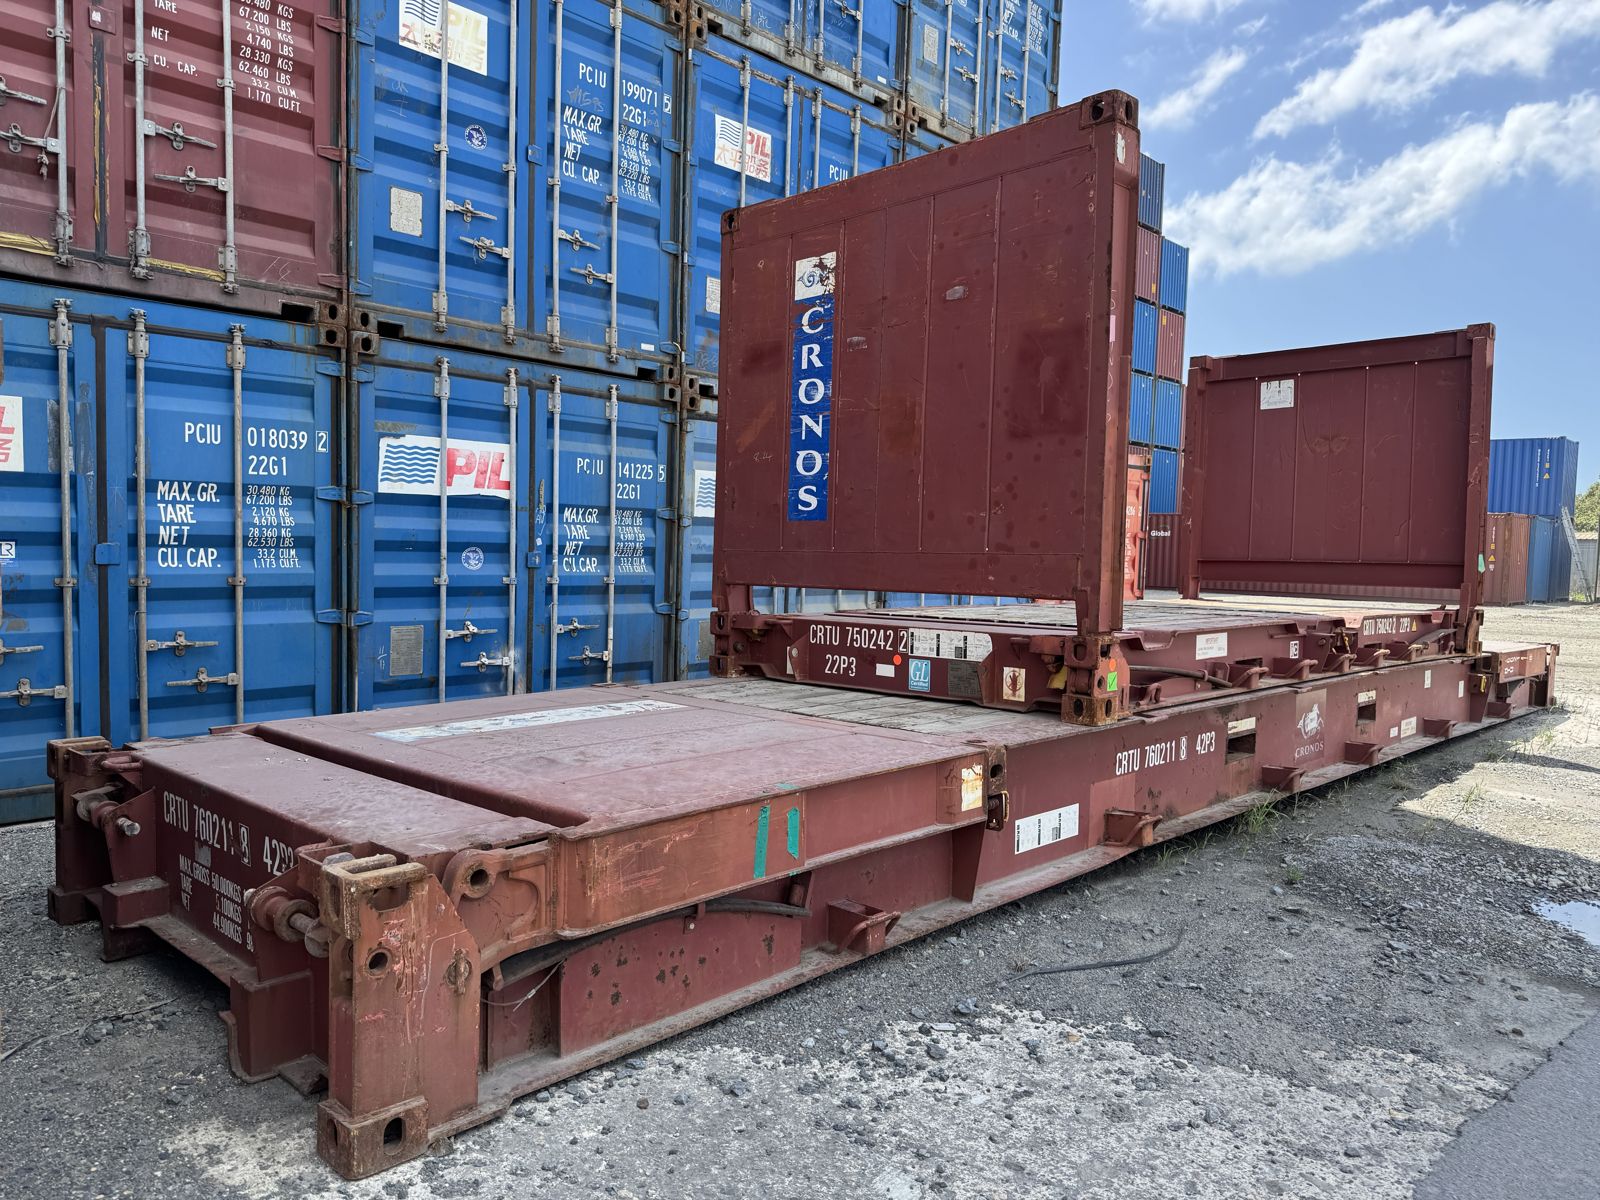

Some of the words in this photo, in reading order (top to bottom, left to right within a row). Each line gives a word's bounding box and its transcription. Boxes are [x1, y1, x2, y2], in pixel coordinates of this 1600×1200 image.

[239, 6, 270, 24] 67.200
[276, 18, 291, 32] LBS
[277, 4, 294, 18] KGS
[151, 26, 169, 42] NET
[245, 21, 270, 36] 2.150
[277, 32, 293, 45] KGS
[247, 33, 271, 50] 4.740
[278, 43, 294, 57] LBS
[153, 55, 169, 68] CU.
[177, 61, 198, 77] CAP.
[240, 45, 270, 64] 28.330
[277, 57, 293, 72] KGS
[238, 60, 269, 78] 62.460
[276, 71, 291, 86] LBS
[251, 77, 271, 90] 33.2
[248, 87, 271, 104] 1.170
[579, 62, 607, 88] PCIU
[622, 79, 658, 108] 199071
[664, 94, 671, 113] 5
[623, 103, 647, 127] 22G1
[563, 124, 590, 146] TARE
[563, 140, 582, 161] NET
[563, 160, 577, 179] CU.
[796, 305, 825, 511] CRONOS
[184, 422, 221, 445] PCIU
[247, 427, 308, 450] 018039
[317, 431, 327, 452] 2
[248, 455, 287, 476] 22G1
[446, 447, 511, 491] PIL
[576, 458, 604, 475] PCIU
[618, 462, 654, 480] 141225
[659, 465, 665, 481] 5
[246, 495, 275, 505] 67.200
[278, 496, 293, 506] LBS
[247, 485, 276, 495] 30.480
[280, 486, 290, 496] KG
[616, 483, 641, 500] 22G1
[157, 504, 196, 523] TARE
[252, 506, 276, 517] 2.120
[279, 507, 290, 517] KG
[254, 516, 278, 526] 4.670
[281, 517, 295, 527] LBS
[158, 525, 190, 545] NET
[247, 538, 277, 547] 62.530
[280, 538, 294, 547] LBS
[248, 527, 278, 538] 28.360
[281, 528, 292, 538] KG
[563, 524, 591, 540] TARE
[257, 548, 275, 559] 33.2
[563, 541, 584, 556] NET
[253, 558, 277, 568] 1.173
[809, 624, 840, 646] CRTU
[845, 626, 894, 651] 750242
[899, 630, 907, 652] 2
[824, 653, 856, 677] 22P3
[910, 659, 929, 682] GL
[1115, 748, 1140, 776] CRTU
[1144, 740, 1176, 768] 760211
[1180, 737, 1186, 759] 8
[1195, 731, 1216, 755] 42P3
[1295, 740, 1324, 758] CRONOS
[163, 790, 189, 832] CRTU
[193, 803, 233, 856] 760211
[240, 826, 249, 864] 8
